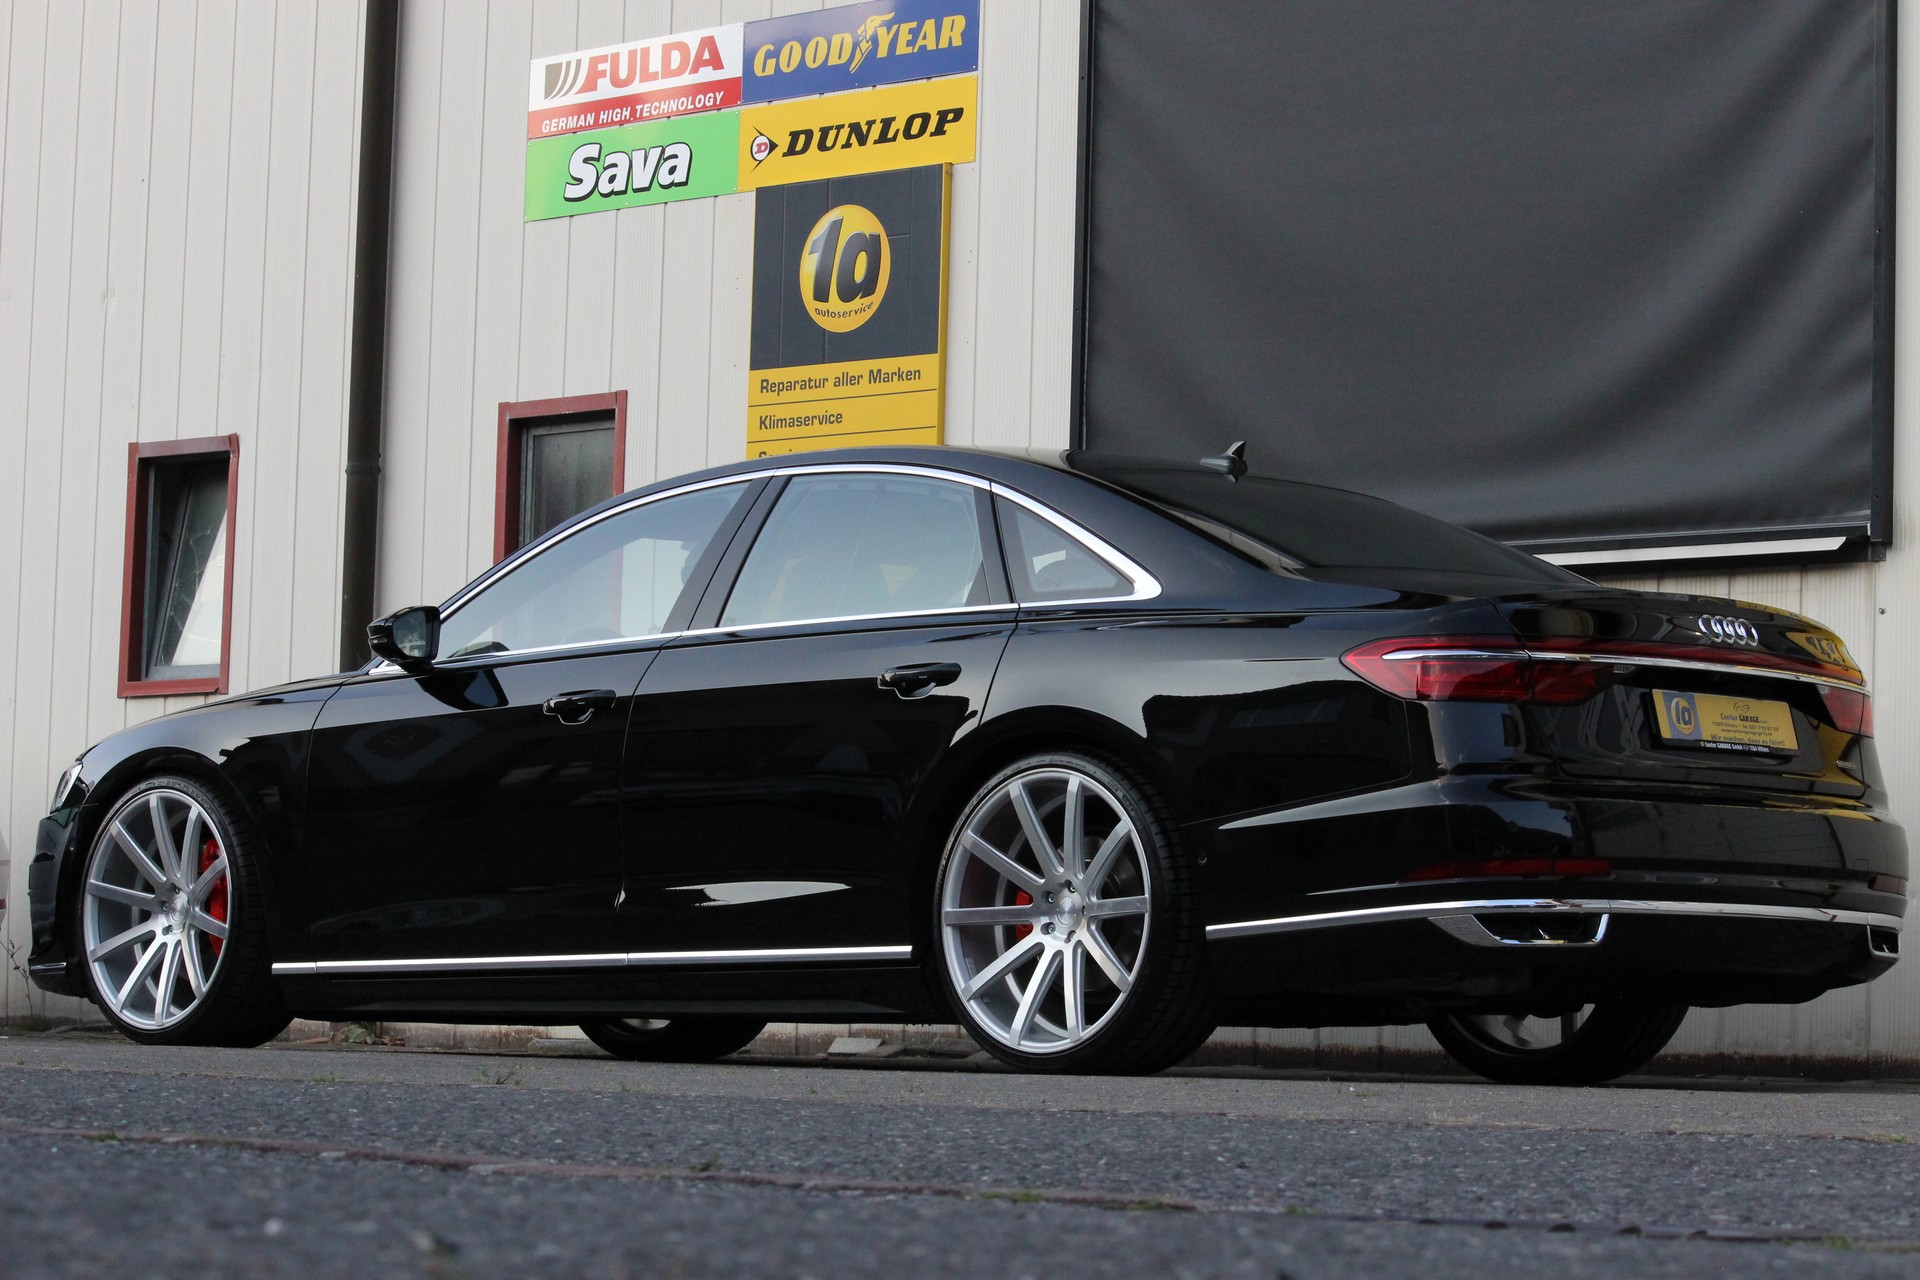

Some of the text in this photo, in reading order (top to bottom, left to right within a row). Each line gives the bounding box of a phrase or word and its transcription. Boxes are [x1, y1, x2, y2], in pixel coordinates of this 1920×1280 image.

[574, 36, 726, 95] FULDA
[542, 91, 725, 133] GERMAN HIGH TECHNOLOGY
[782, 107, 965, 158] DUNLOP
[563, 141, 693, 202] Sava
[808, 216, 882, 303] 1a
[814, 301, 874, 319] autoservice
[760, 367, 921, 396] Reparatur aller Marken
[759, 410, 843, 430] Klimaservice
[1739, 715, 1760, 723] GARAGE
